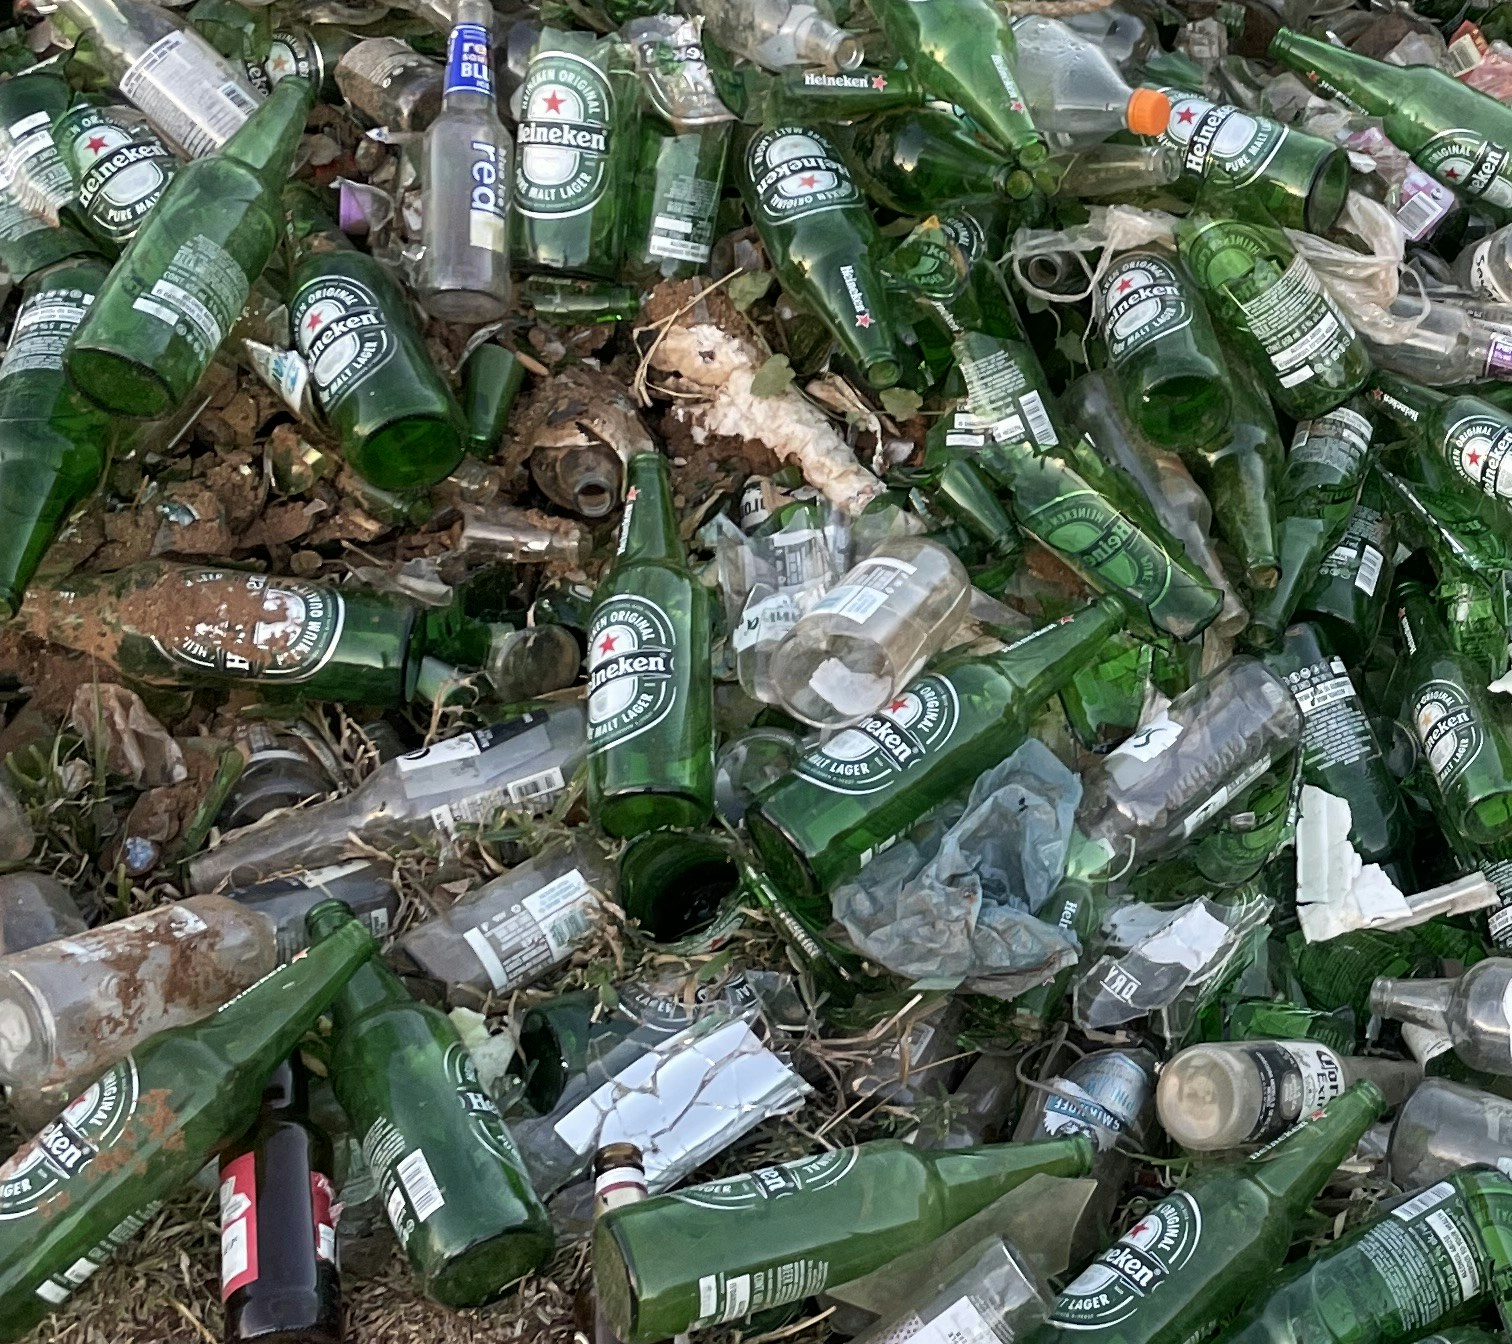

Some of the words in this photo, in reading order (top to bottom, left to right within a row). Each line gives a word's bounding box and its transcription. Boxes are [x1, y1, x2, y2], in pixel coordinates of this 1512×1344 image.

[558, 69, 601, 115] ORIGINAL
[805, 73, 870, 89] Heineken
[1186, 104, 1237, 171] Heineke
[756, 158, 852, 197] Heineken
[1225, 150, 1251, 173] PURE
[1469, 149, 1501, 195] eken
[528, 186, 557, 201] MALT
[559, 172, 593, 200] LAGER
[107, 205, 134, 223] PURE
[307, 285, 357, 306] ORIGINAL
[840, 264, 865, 313] Heineken
[306, 309, 379, 367] ineken
[350, 340, 379, 378] LAGER
[1455, 425, 1494, 450] ORIGINAL
[610, 609, 656, 642] ORIGINAL
[589, 654, 667, 689] ineken
[621, 692, 655, 725] LAGER
[918, 685, 939, 732] ORIGINAL
[859, 716, 914, 763] neken
[829, 761, 870, 776] LAGER
[1159, 1203, 1181, 1251] ORIGINAL
[1102, 1246, 1158, 1288] eken
[1066, 1293, 1111, 1312] LAGER
